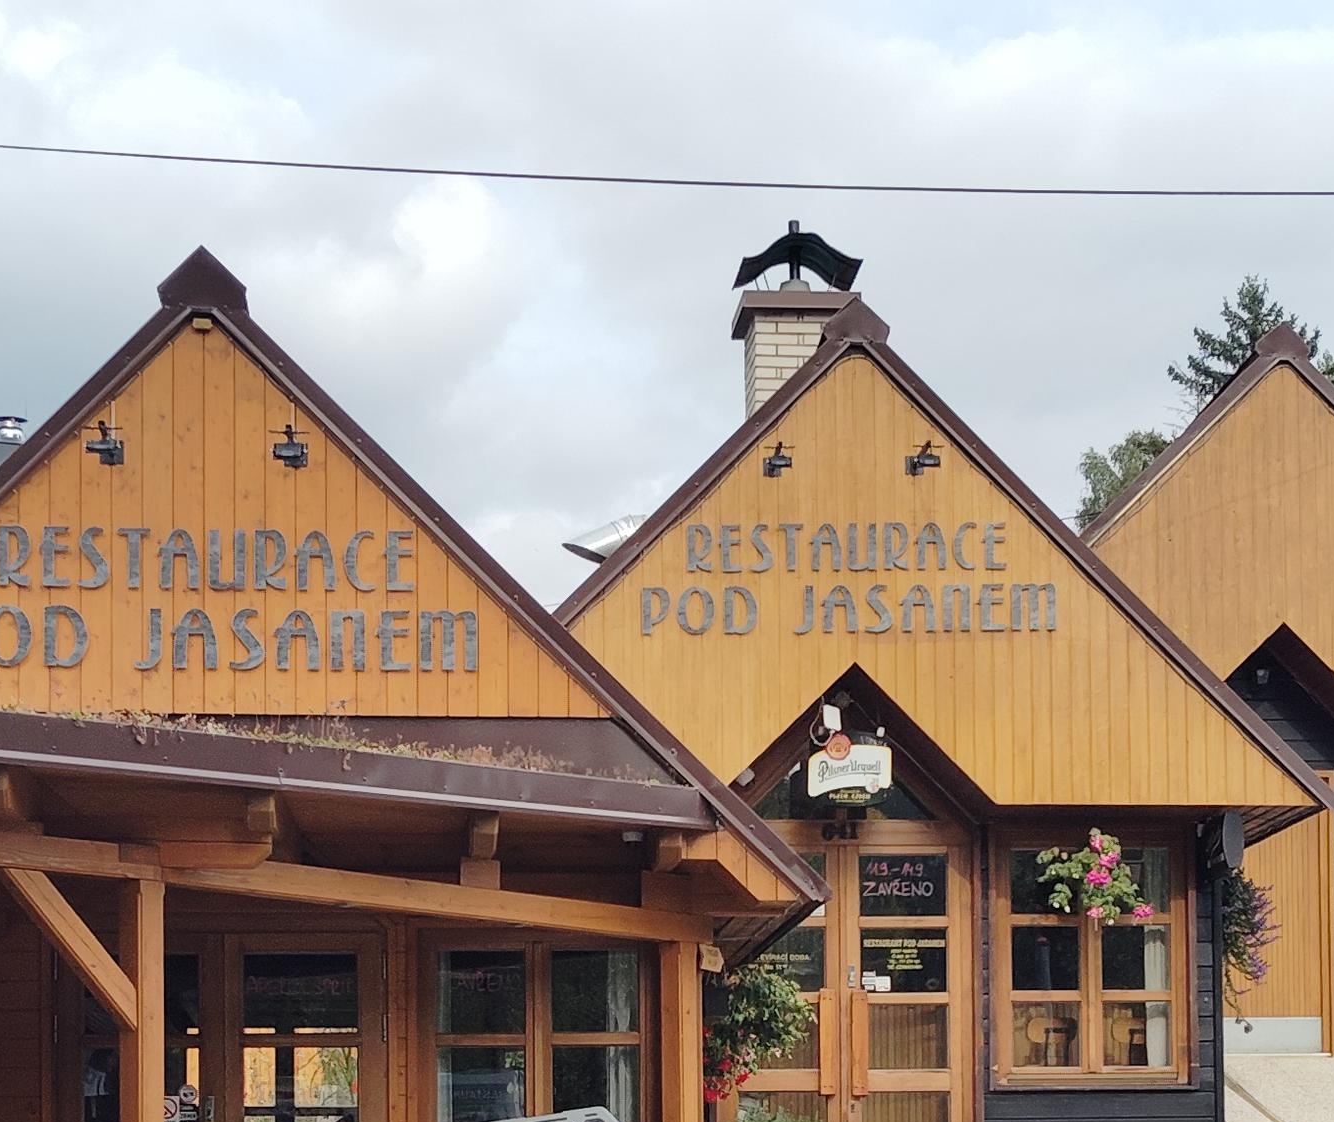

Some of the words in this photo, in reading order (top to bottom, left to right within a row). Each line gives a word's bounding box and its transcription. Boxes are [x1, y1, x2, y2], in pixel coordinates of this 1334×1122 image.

[685, 521, 1008, 573] RESTAURACE
[640, 586, 758, 636] POD
[793, 583, 1058, 634] JASANEM
[134, 608, 478, 672] JASANEM
[818, 760, 850, 783] Pilsner
[850, 760, 881, 774] Urquell
[862, 878, 934, 897] ZAVŘENO
